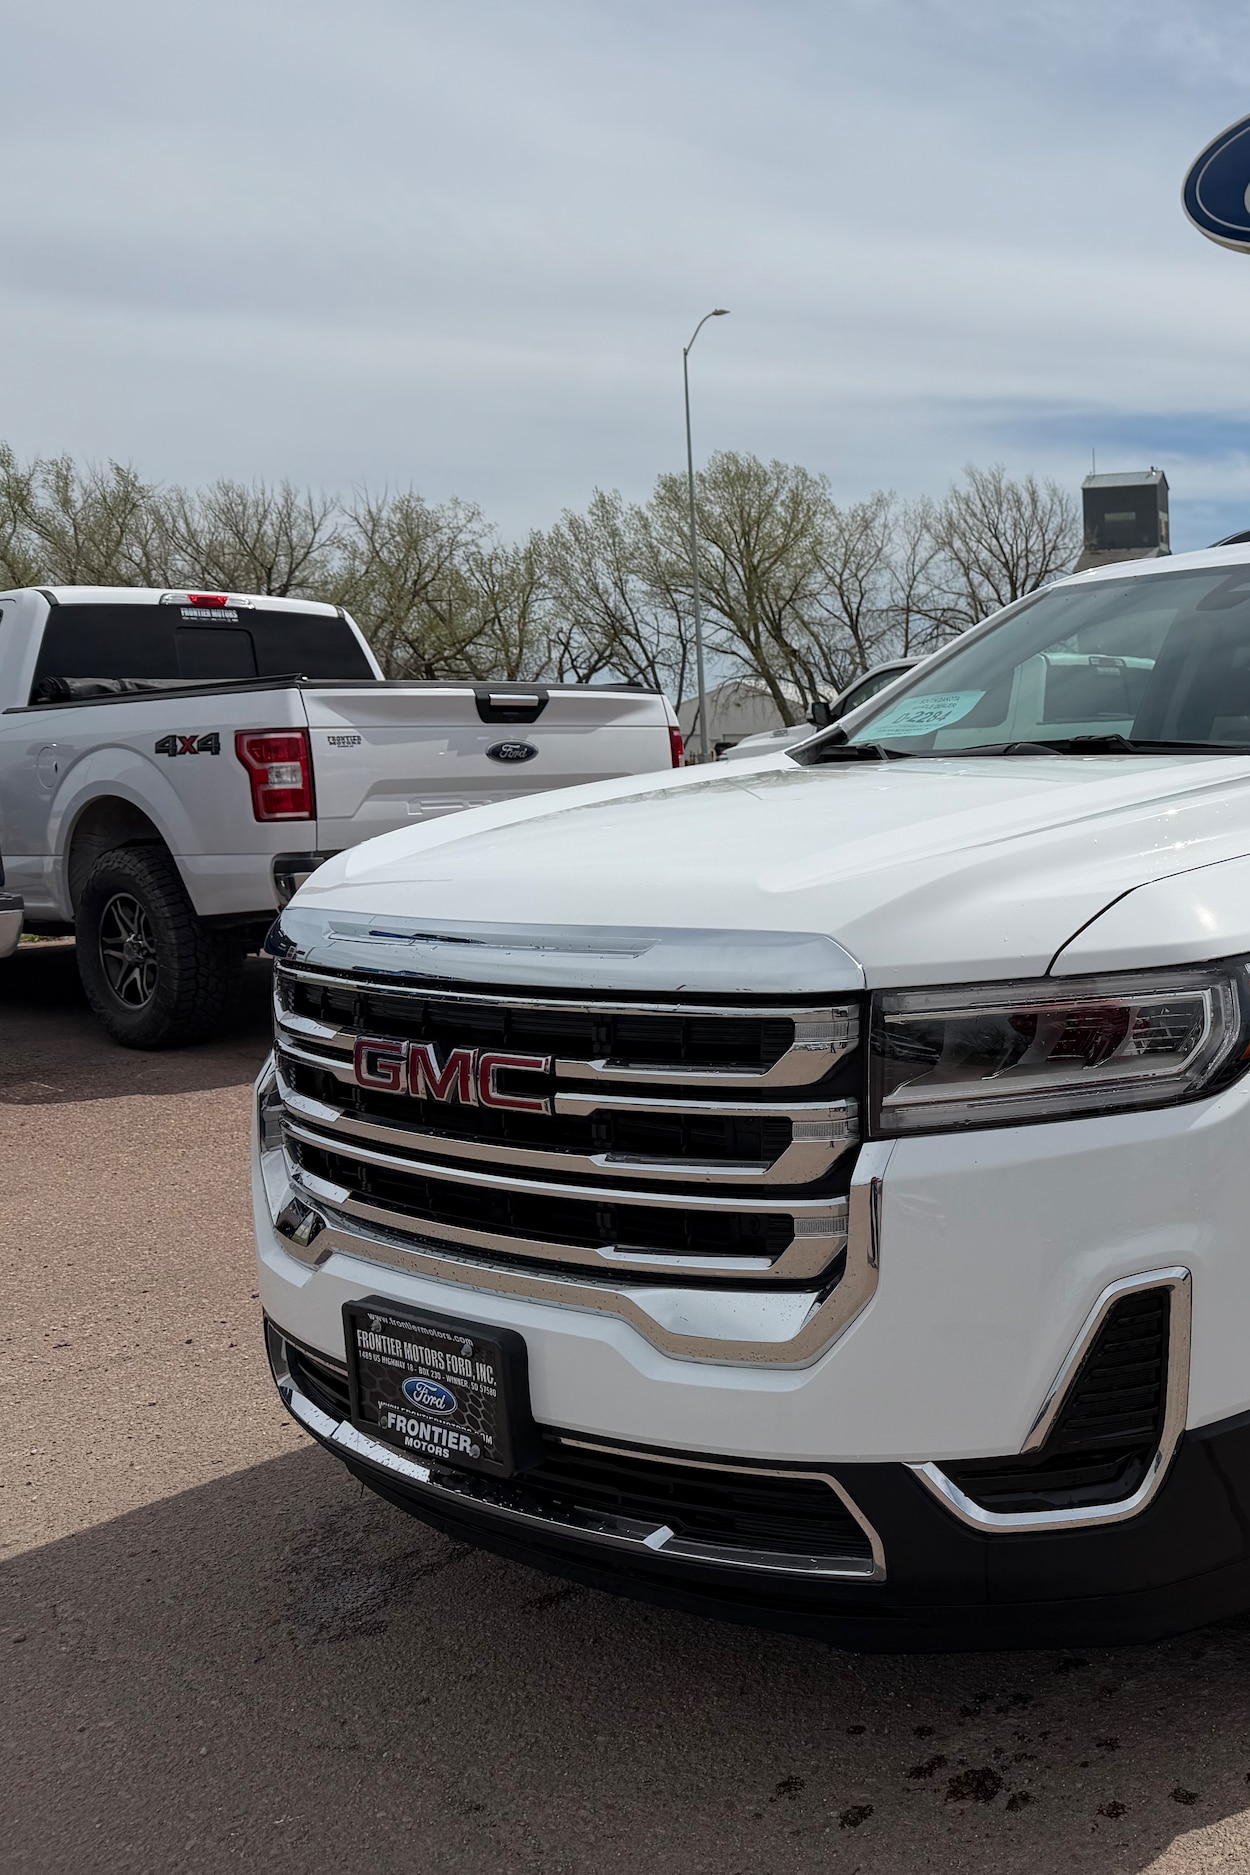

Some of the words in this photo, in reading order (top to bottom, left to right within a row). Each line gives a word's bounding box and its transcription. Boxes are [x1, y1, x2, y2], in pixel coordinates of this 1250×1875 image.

[892, 710, 953, 724] D-2284
[500, 744, 527, 758] Ford
[354, 1036, 552, 1115] GMC
[356, 1329, 402, 1358] FRONTIER
[403, 1342, 445, 1370] MOTORS
[382, 1355, 406, 1370] HIGHWAY
[418, 1365, 429, 1377] BOX
[413, 1381, 446, 1410] Ford
[387, 1412, 472, 1454] FRONTIER
[404, 1436, 450, 1459] MOTORS
